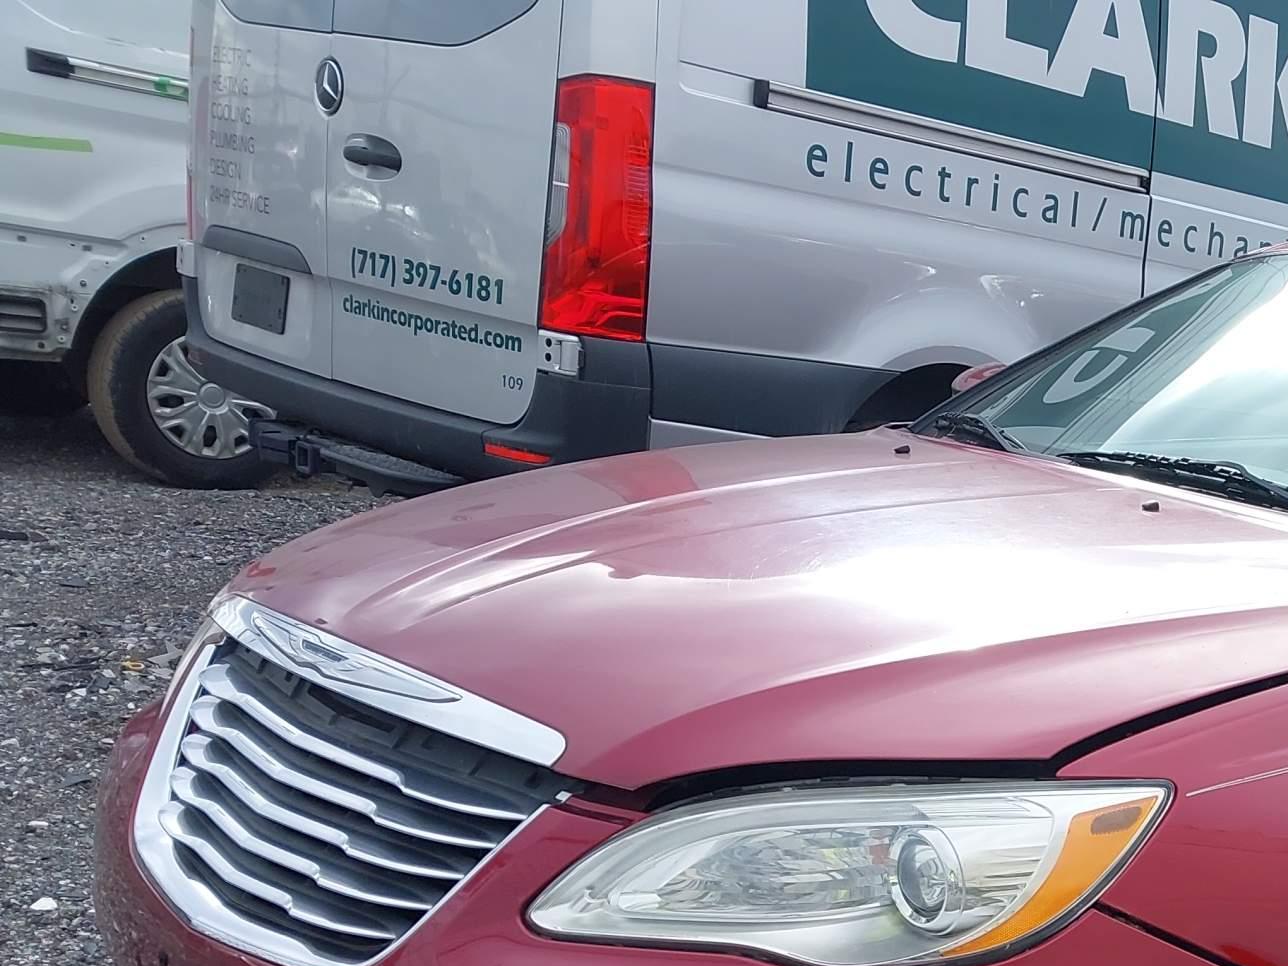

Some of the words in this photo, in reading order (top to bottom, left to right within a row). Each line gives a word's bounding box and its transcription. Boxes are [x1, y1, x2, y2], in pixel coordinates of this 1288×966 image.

[351, 247, 396, 287] (717)
[402, 258, 504, 305] 397-6181
[343, 294, 522, 352] clarkincorporated.com
[502, 374, 523, 391] 109
